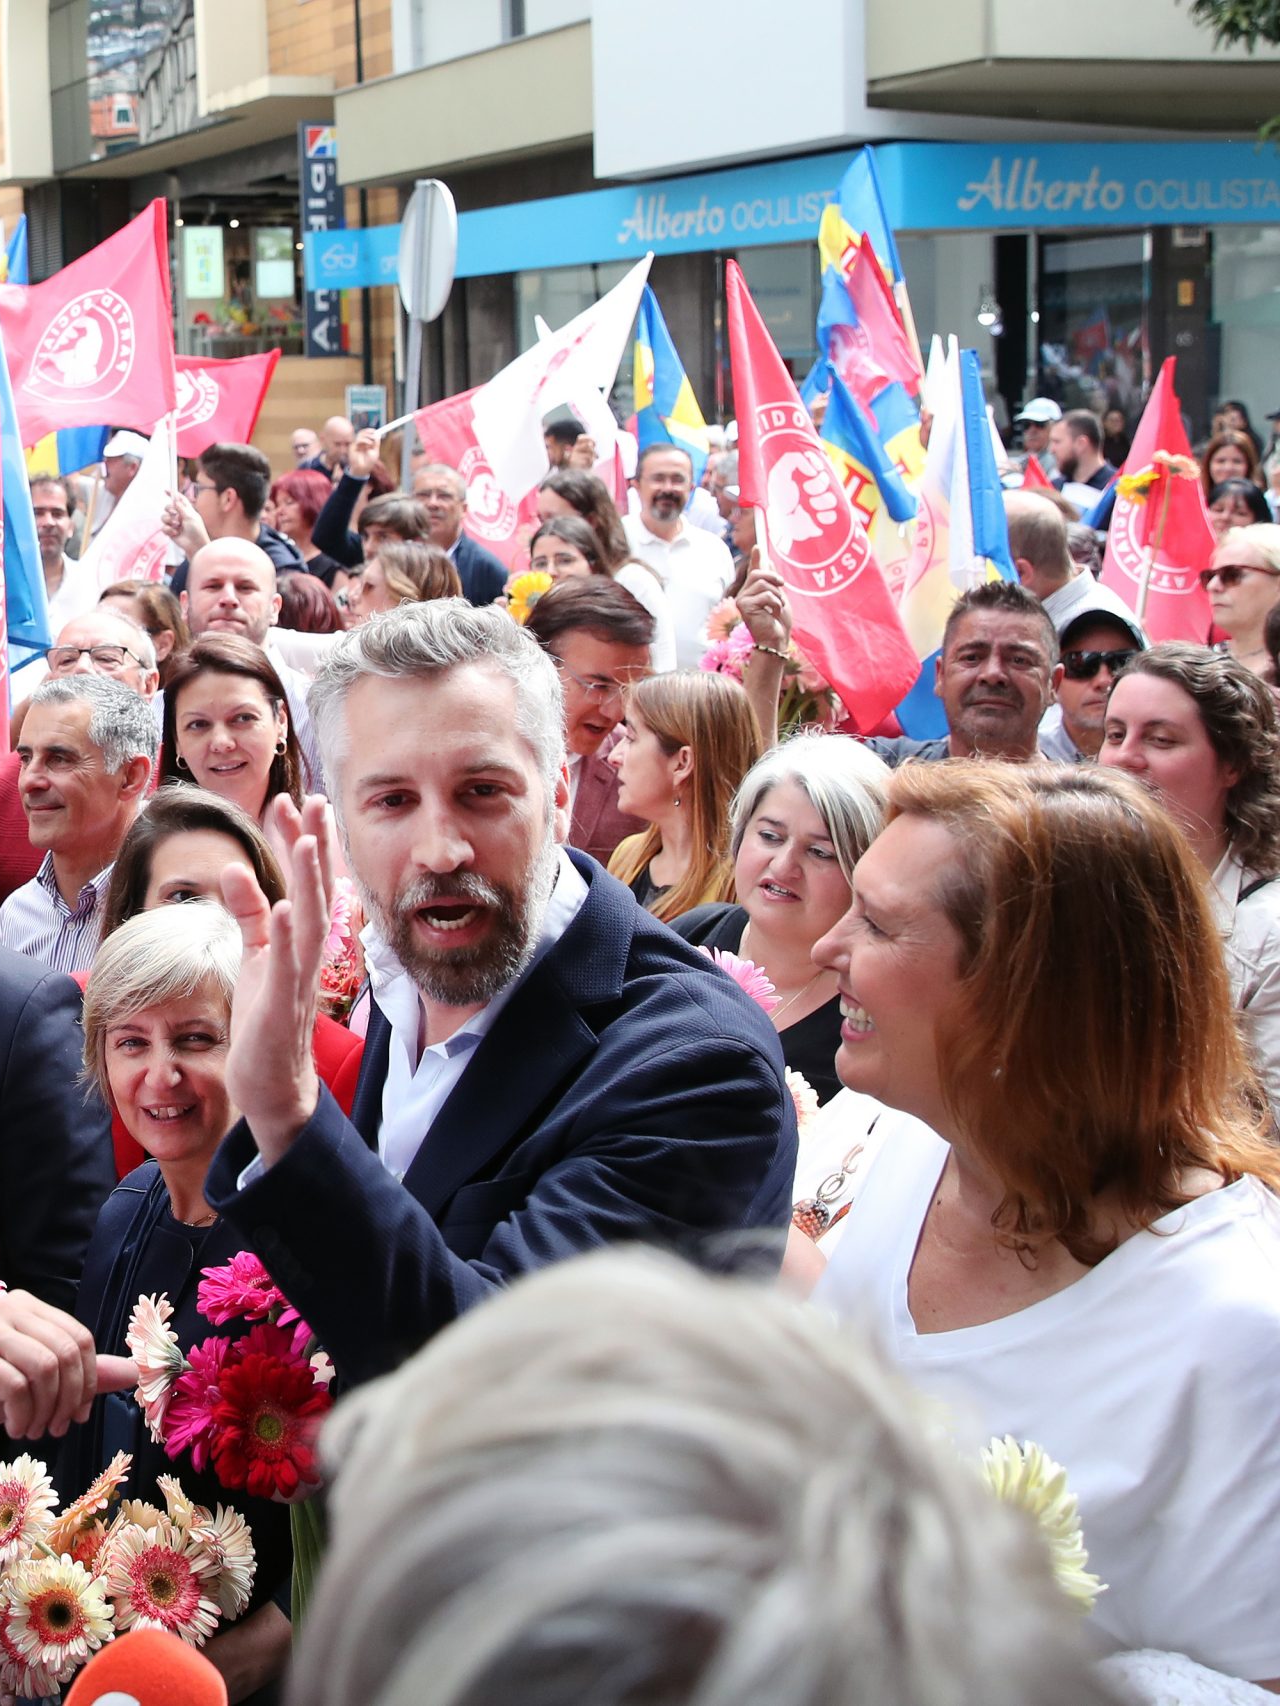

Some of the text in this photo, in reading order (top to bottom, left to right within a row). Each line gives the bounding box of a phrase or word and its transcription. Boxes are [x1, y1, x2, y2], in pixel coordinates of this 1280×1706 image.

[956, 156, 1280, 212] Alberto OCULISTA
[616, 193, 725, 244] Alberto
